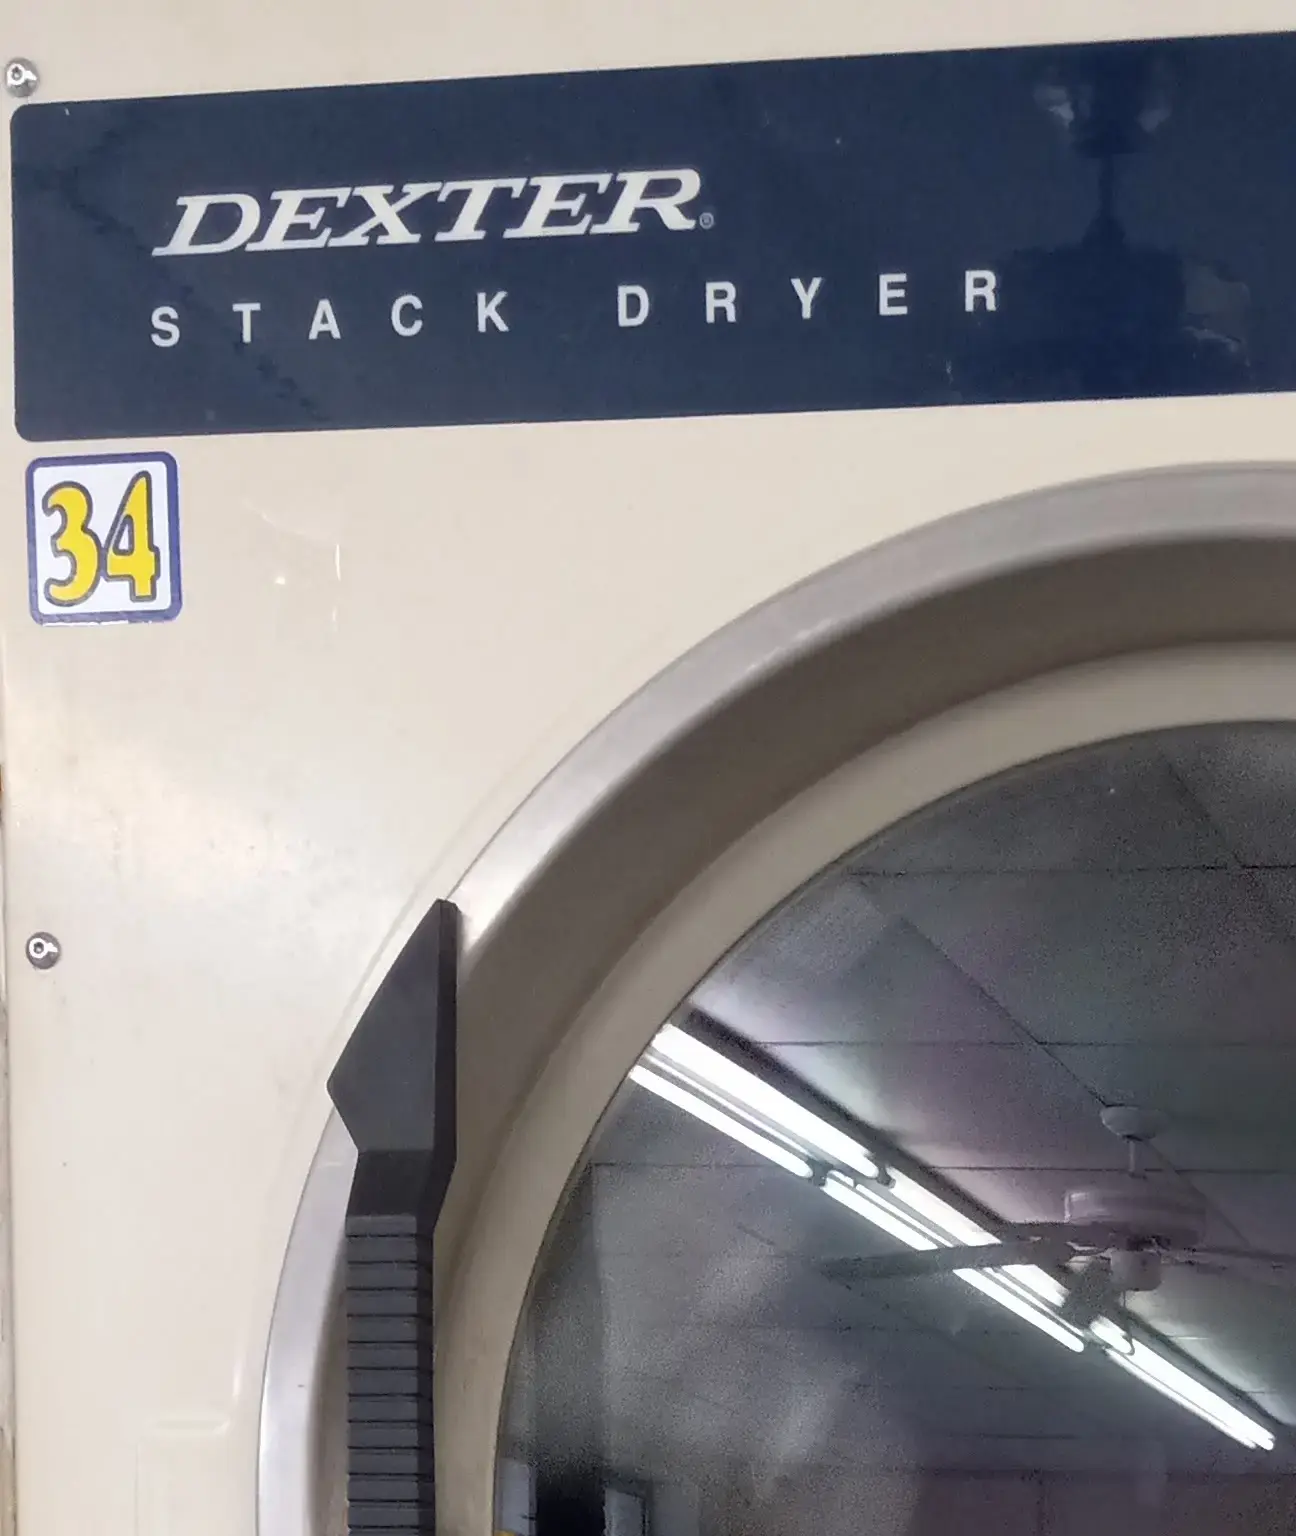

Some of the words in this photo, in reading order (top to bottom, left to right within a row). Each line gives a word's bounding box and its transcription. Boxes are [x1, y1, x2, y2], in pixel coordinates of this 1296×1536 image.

[151, 168, 703, 258] DEXTER
[150, 290, 510, 348] STACK
[617, 269, 998, 329] DRYER
[41, 470, 162, 608] 34
